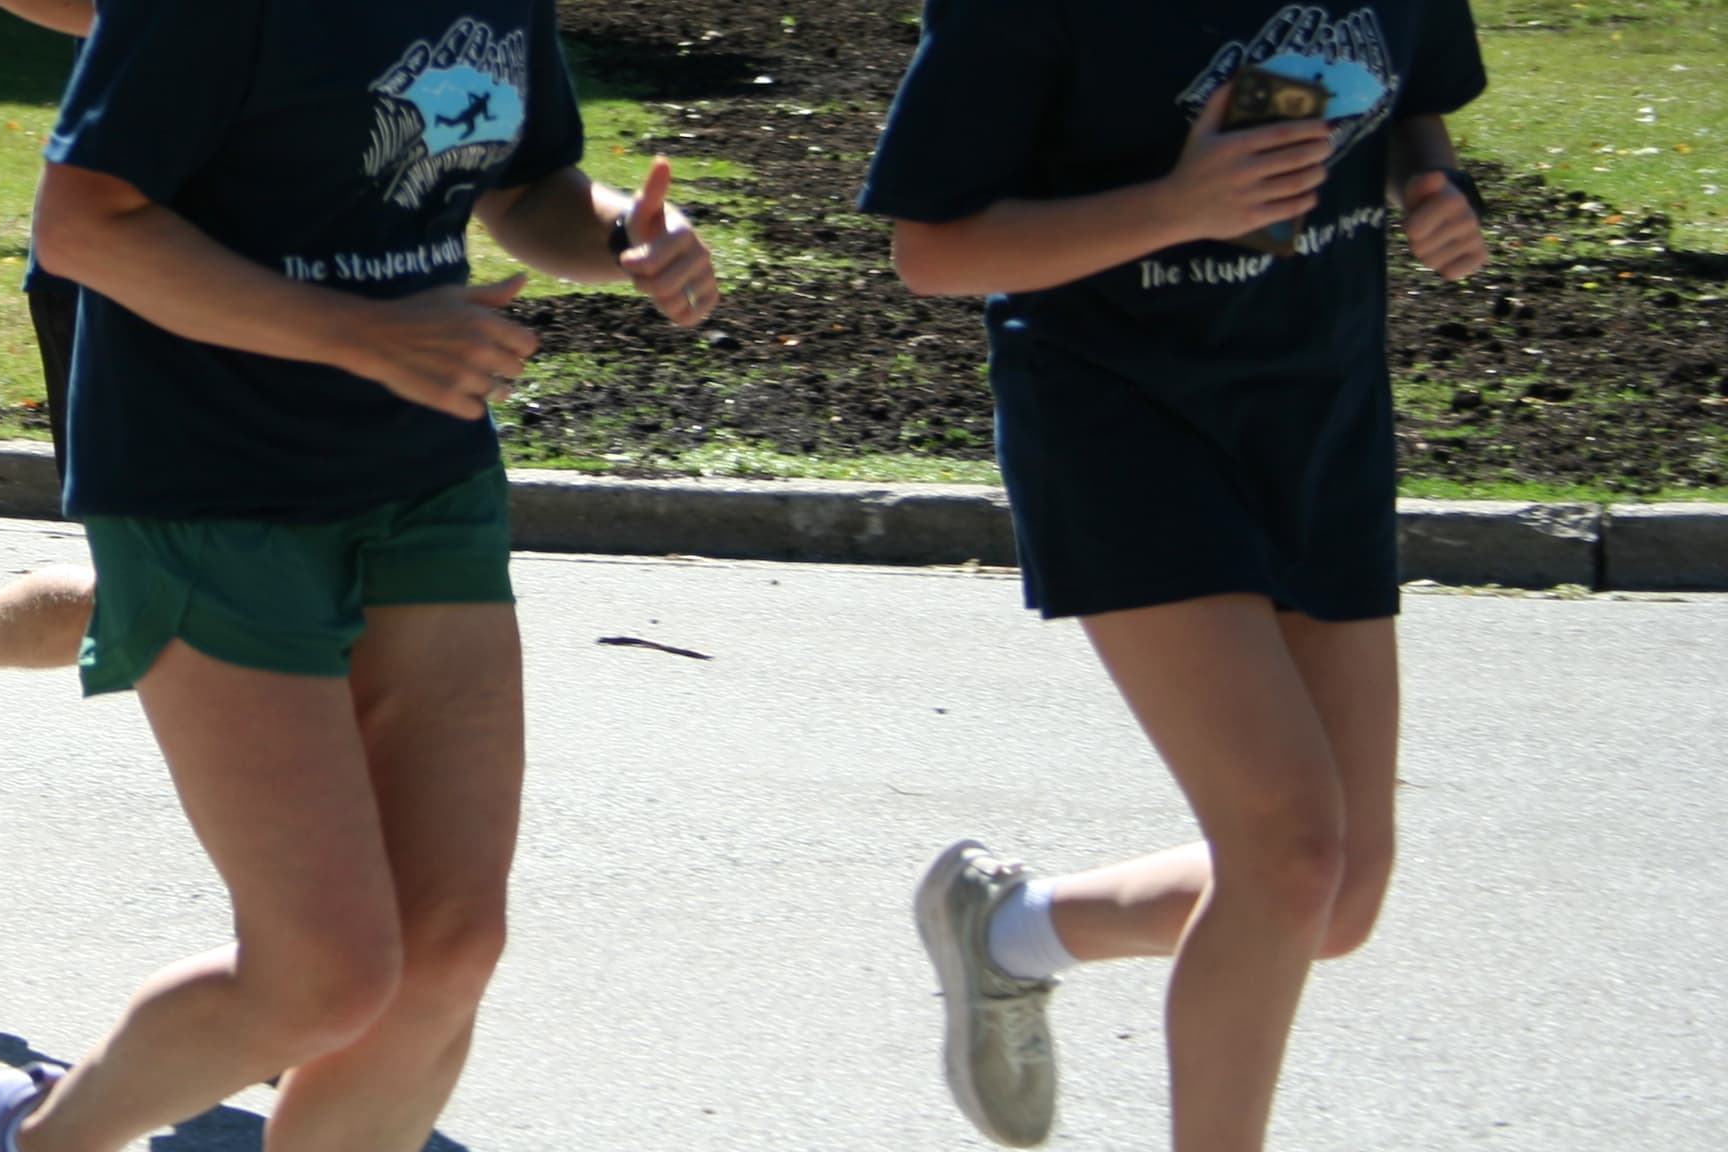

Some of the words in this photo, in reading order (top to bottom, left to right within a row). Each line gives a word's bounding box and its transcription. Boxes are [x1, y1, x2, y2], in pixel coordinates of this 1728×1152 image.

[282, 255, 328, 280] The
[334, 245, 432, 280] Student
[1140, 260, 1181, 290] The
[1189, 253, 1274, 284] Studen
